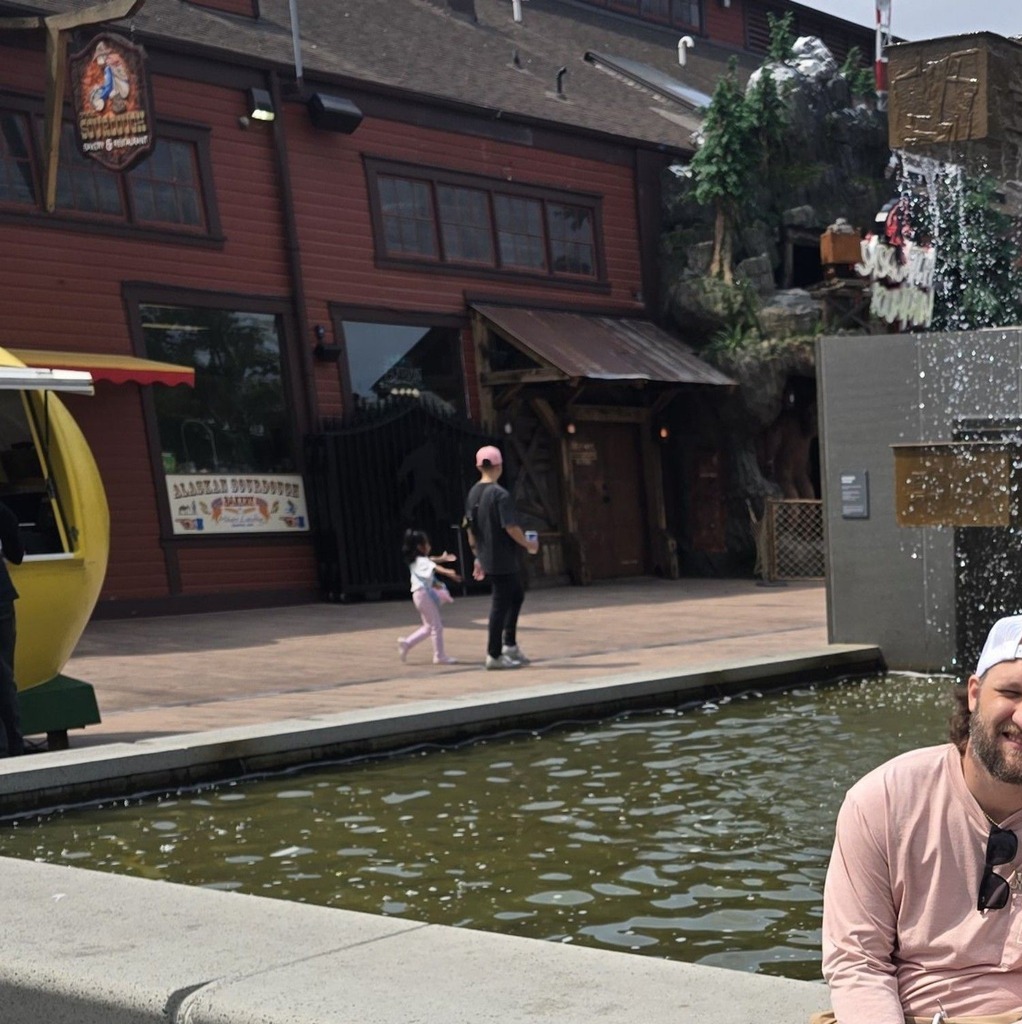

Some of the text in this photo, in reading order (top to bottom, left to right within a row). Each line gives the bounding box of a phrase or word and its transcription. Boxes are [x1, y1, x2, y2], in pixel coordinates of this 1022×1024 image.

[80, 111, 146, 139] SOURDOUGH
[173, 478, 300, 499] ALASKAN SOURDOUGH
[223, 496, 255, 507] BAKERY
